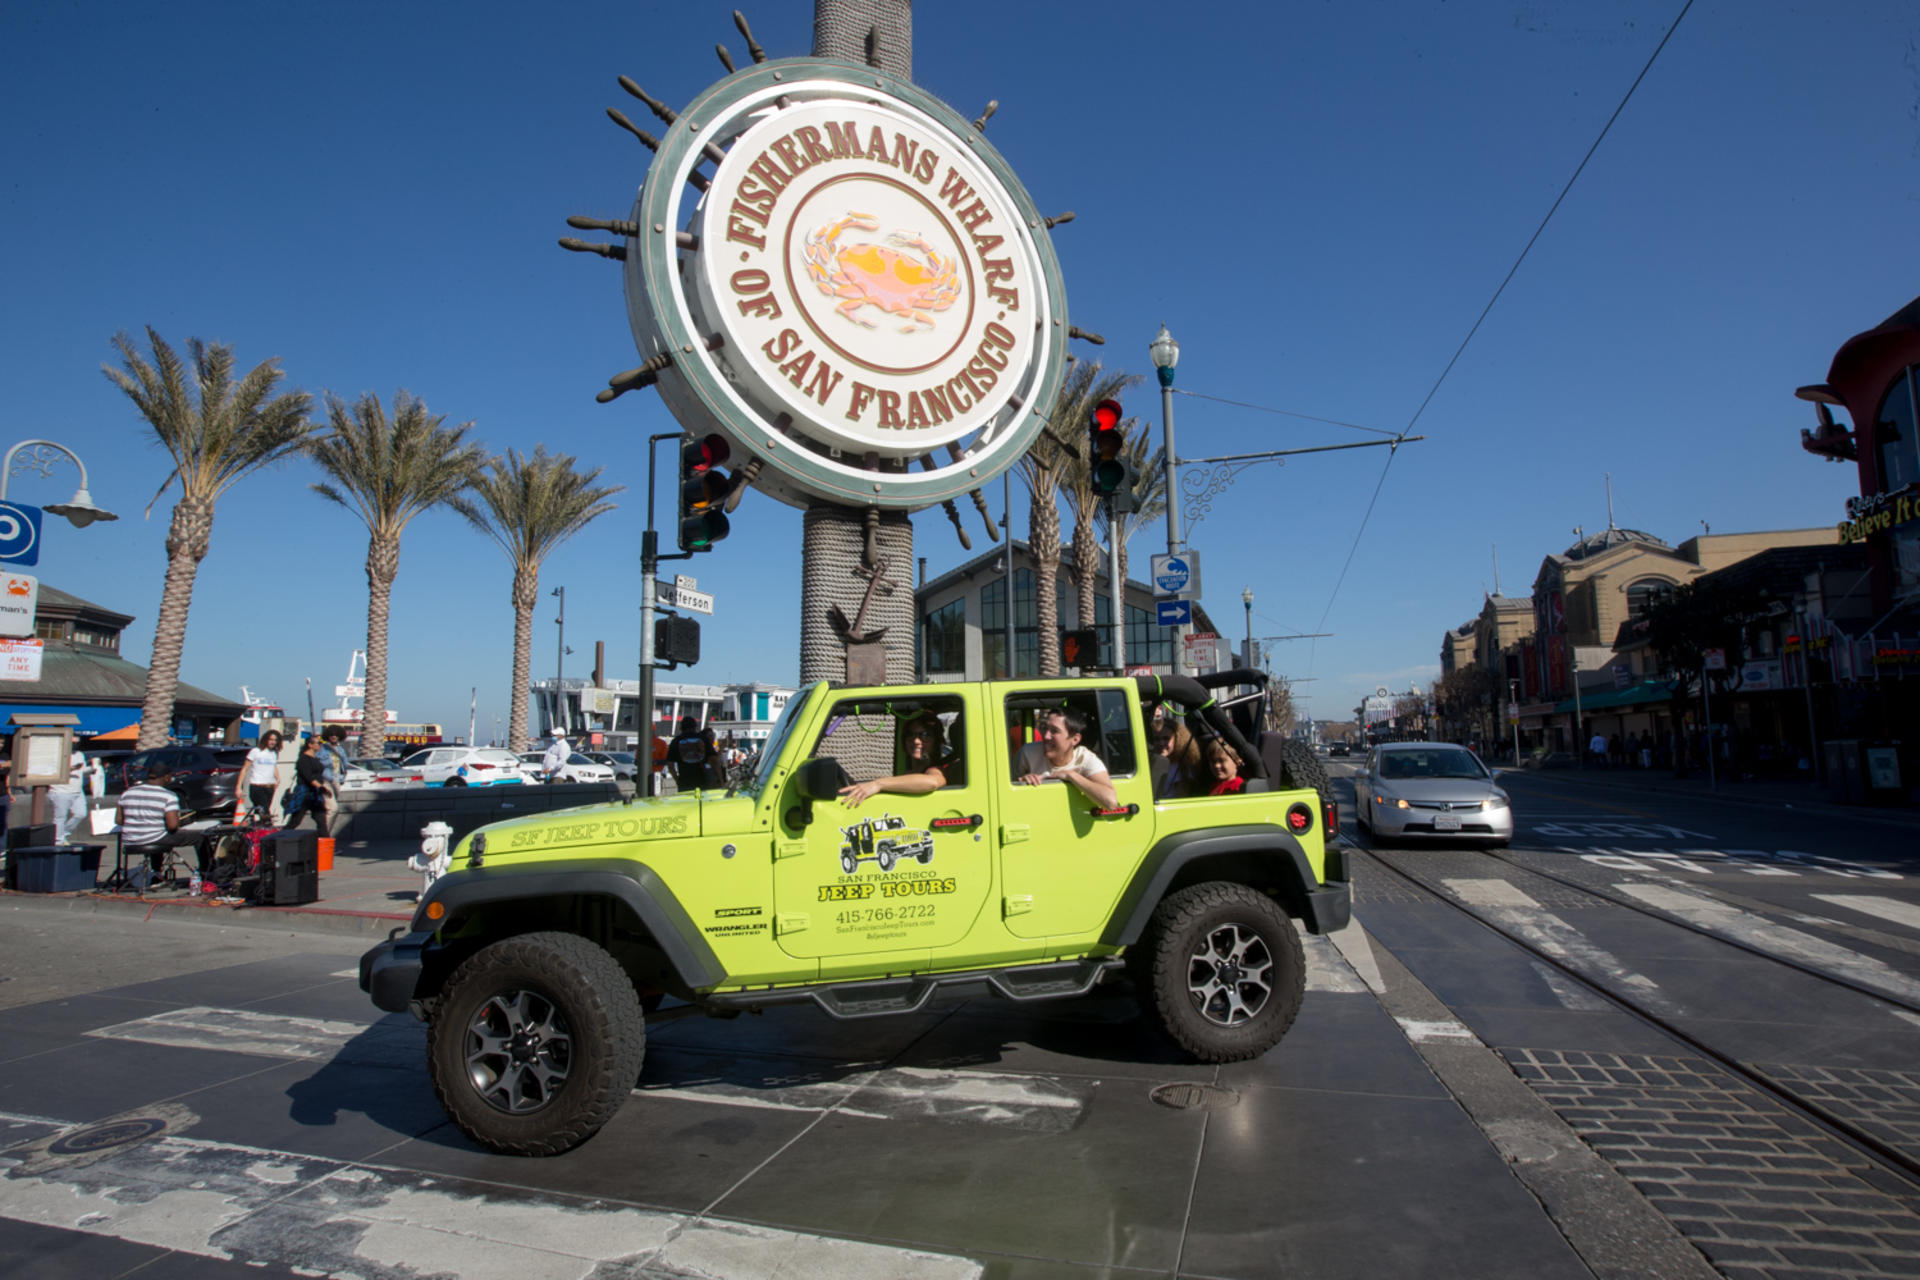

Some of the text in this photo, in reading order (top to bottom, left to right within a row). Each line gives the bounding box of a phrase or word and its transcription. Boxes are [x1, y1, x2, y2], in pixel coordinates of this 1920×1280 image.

[726, 120, 1021, 312] FISHERMANS WHARF
[729, 268, 1017, 431] OF SAN FRANCISCO
[1838, 508, 1892, 545] Believe
[1895, 496, 1911, 524] It
[661, 587, 709, 609] Jefferson
[8, 663, 29, 671] TIME
[1128, 668, 1151, 676] OPEN
[511, 815, 688, 848] SF JEEP TOURS
[837, 871, 937, 884] SAN FRANCISCO
[818, 878, 957, 902] JEEP TOURS
[716, 908, 761, 917] SPORT
[836, 904, 936, 924] 415-766-2722
[704, 923, 768, 933] WRANGLER
